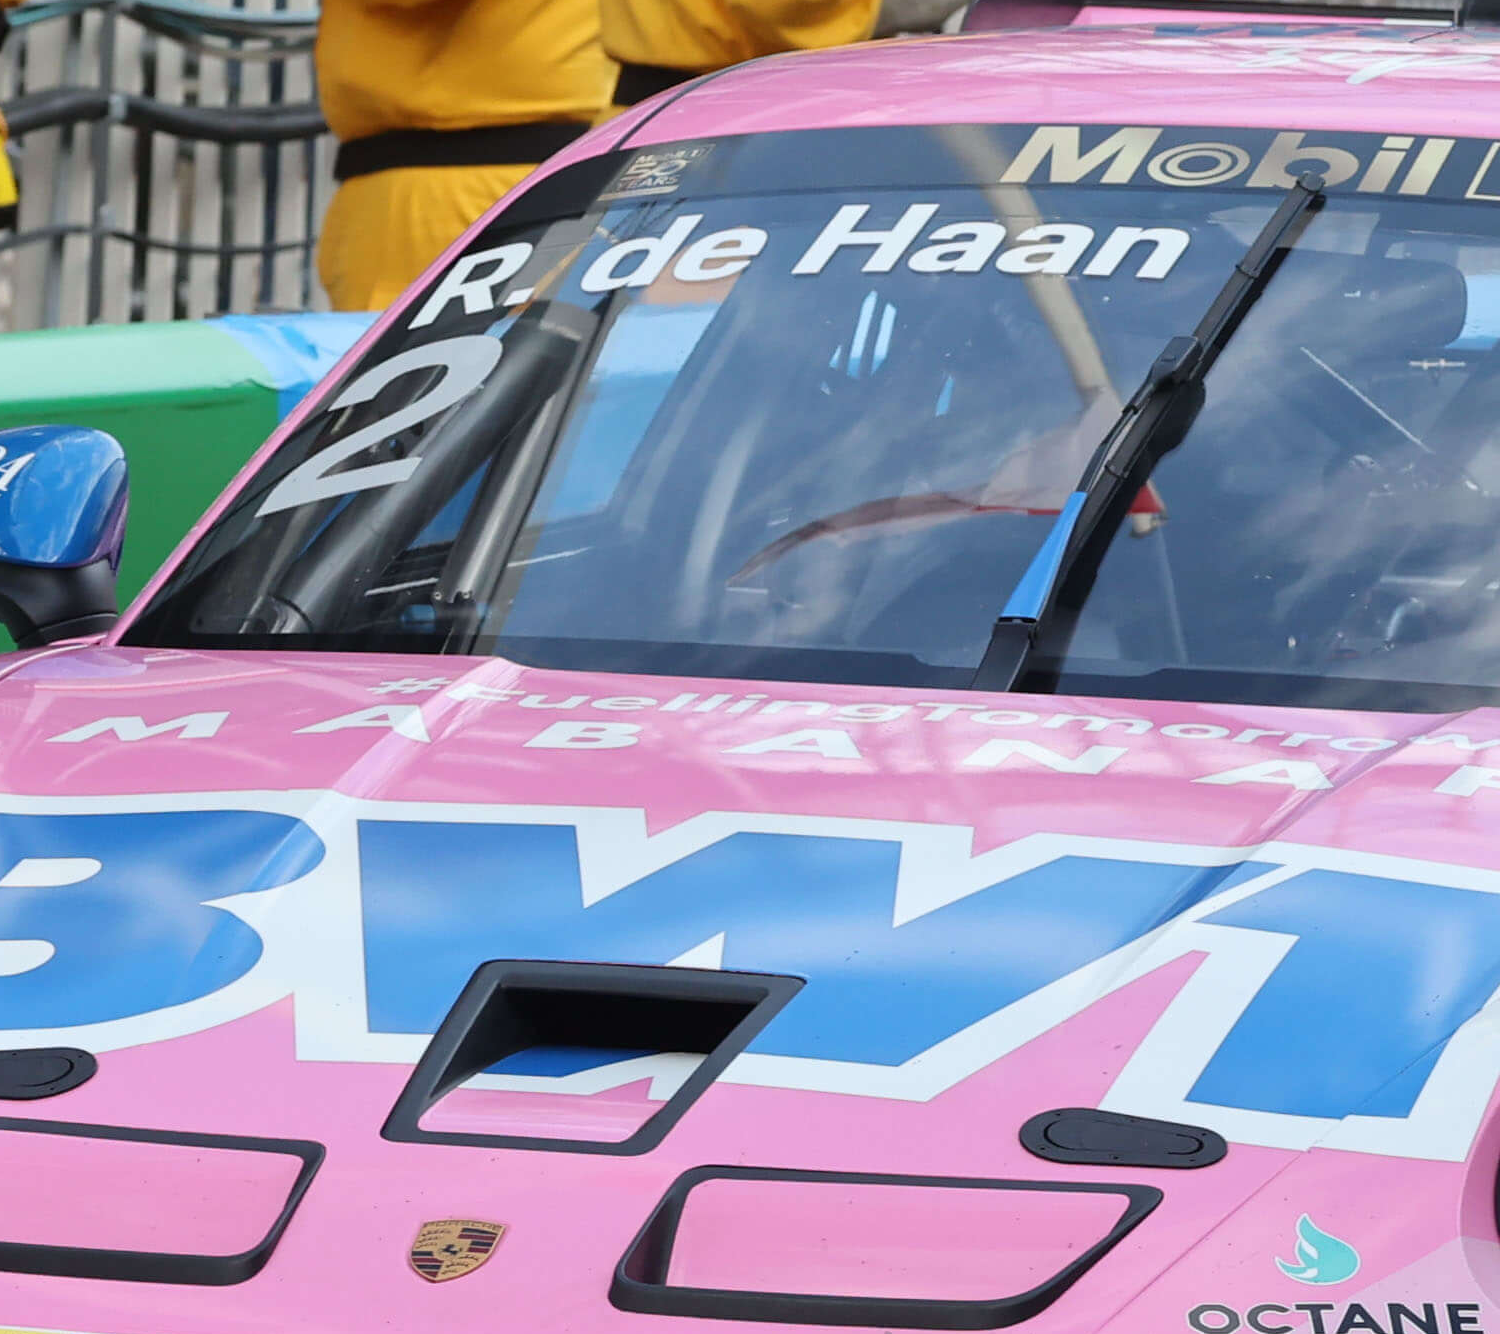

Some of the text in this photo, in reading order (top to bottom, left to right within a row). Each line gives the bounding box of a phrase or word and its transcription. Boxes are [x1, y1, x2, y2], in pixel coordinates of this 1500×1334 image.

[998, 126, 1456, 196] Mobil
[409, 203, 1191, 330] R. de Haan
[254, 334, 502, 519] 2
